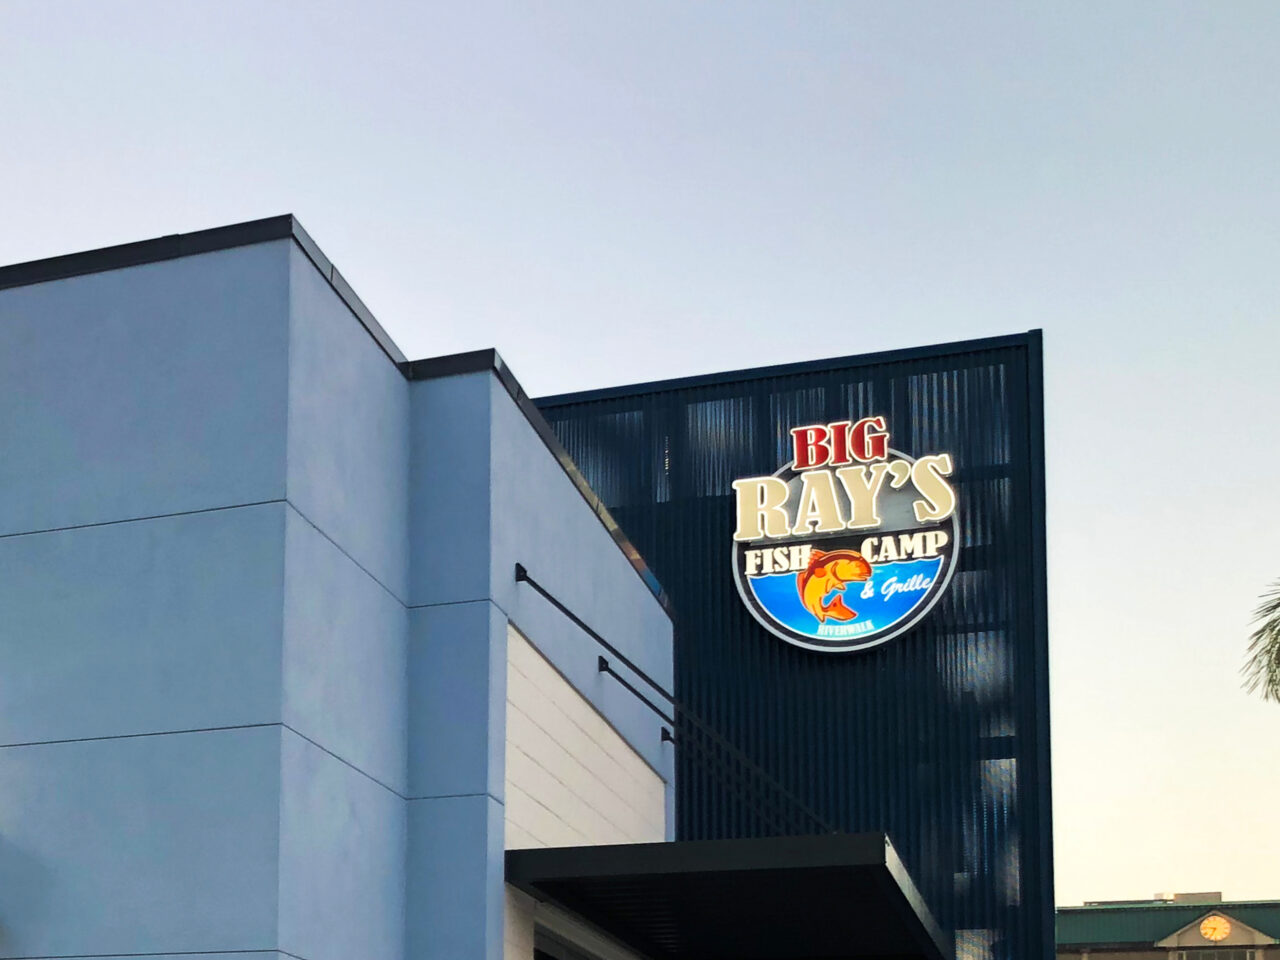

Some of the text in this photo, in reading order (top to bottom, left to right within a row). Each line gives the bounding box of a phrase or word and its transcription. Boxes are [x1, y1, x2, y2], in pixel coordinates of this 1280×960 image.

[790, 416, 889, 471] BIG
[732, 454, 956, 541] RAY'S
[744, 530, 949, 576] FISH CAMP
[860, 573, 933, 602] & Grille
[817, 620, 875, 636] RIVERWALK
